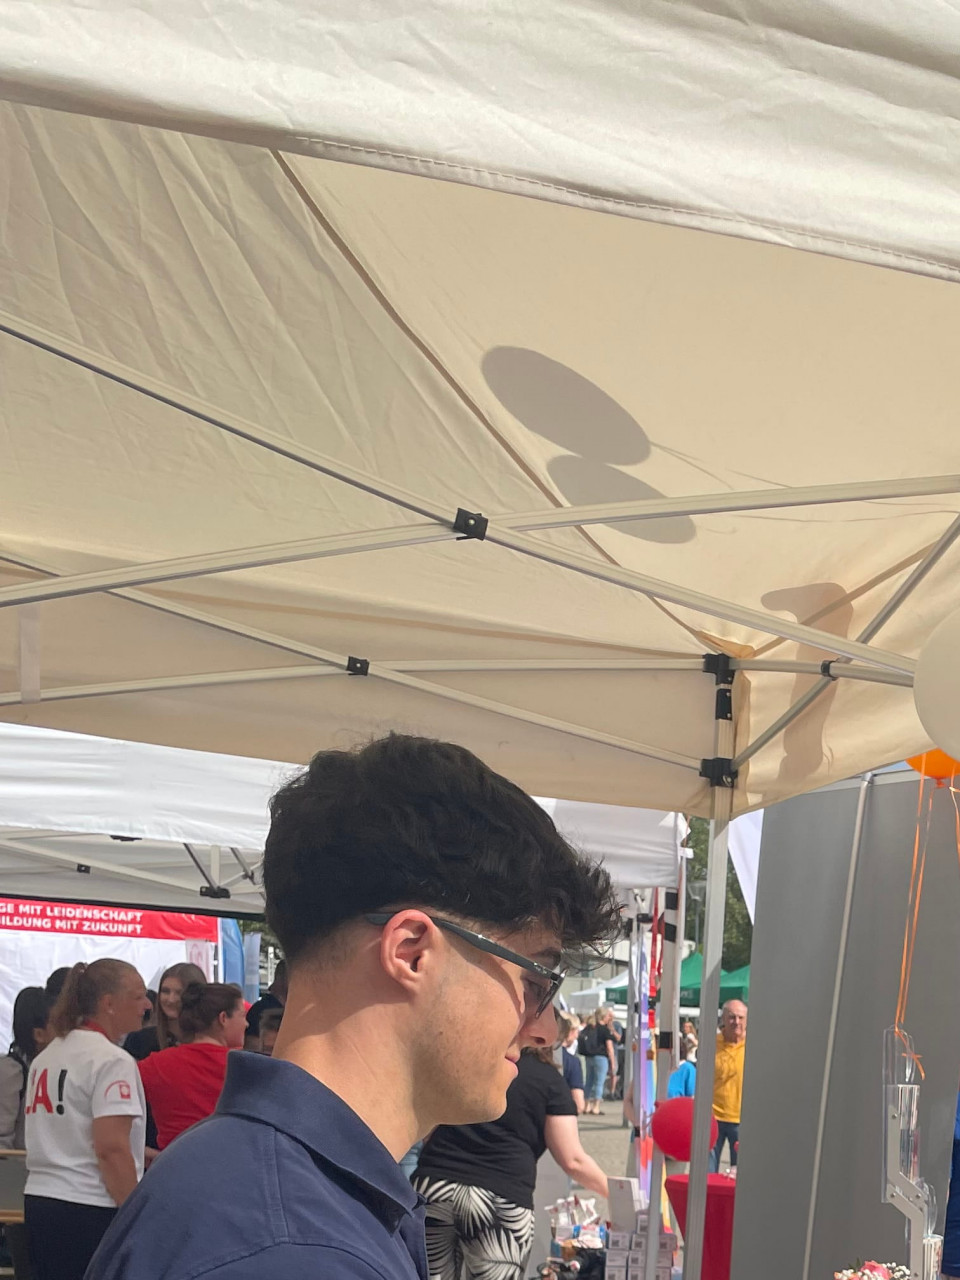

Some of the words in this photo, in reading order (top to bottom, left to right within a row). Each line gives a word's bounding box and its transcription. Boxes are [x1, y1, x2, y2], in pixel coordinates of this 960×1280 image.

[19, 904, 43, 916] MIT
[46, 905, 143, 922] LEIDENSCHAFT
[55, 919, 79, 930] MIT
[82, 920, 143, 935] ZUKUNFT
